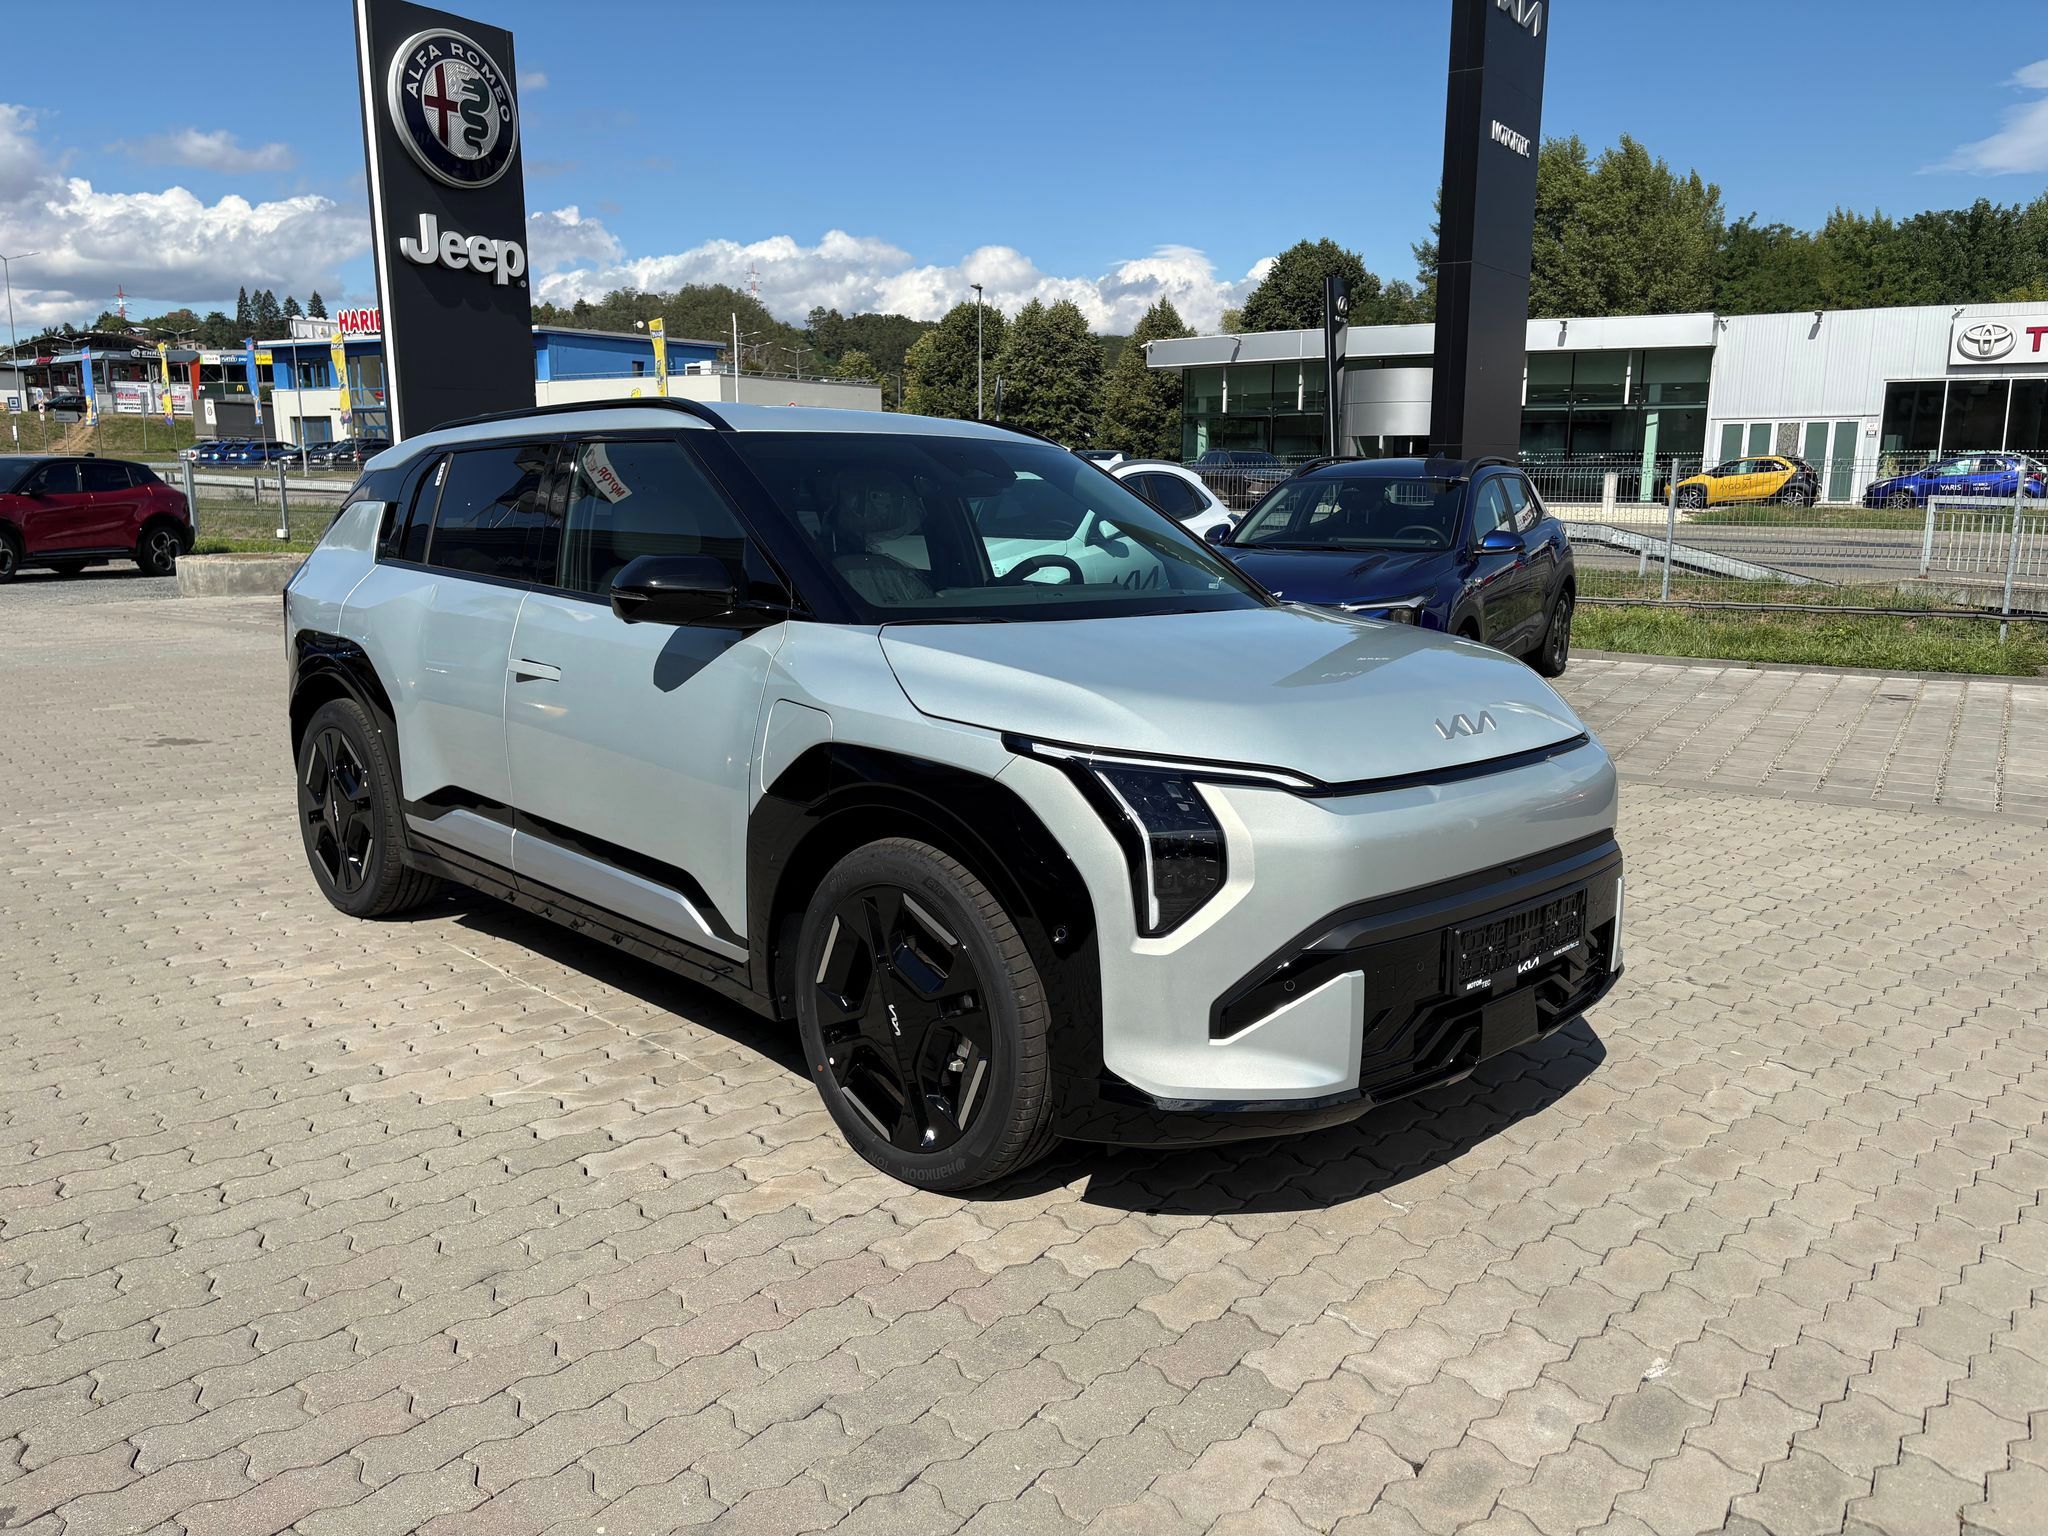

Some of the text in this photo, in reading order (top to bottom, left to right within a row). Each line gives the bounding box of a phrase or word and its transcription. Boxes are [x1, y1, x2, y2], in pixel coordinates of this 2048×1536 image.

[1497, 0, 1543, 38] IA
[406, 42, 511, 123] ALFA ROMEO
[399, 212, 526, 286] Jeep
[338, 308, 382, 333] HARIB
[1434, 710, 1498, 740] KIA
[1517, 956, 1540, 974] KIA
